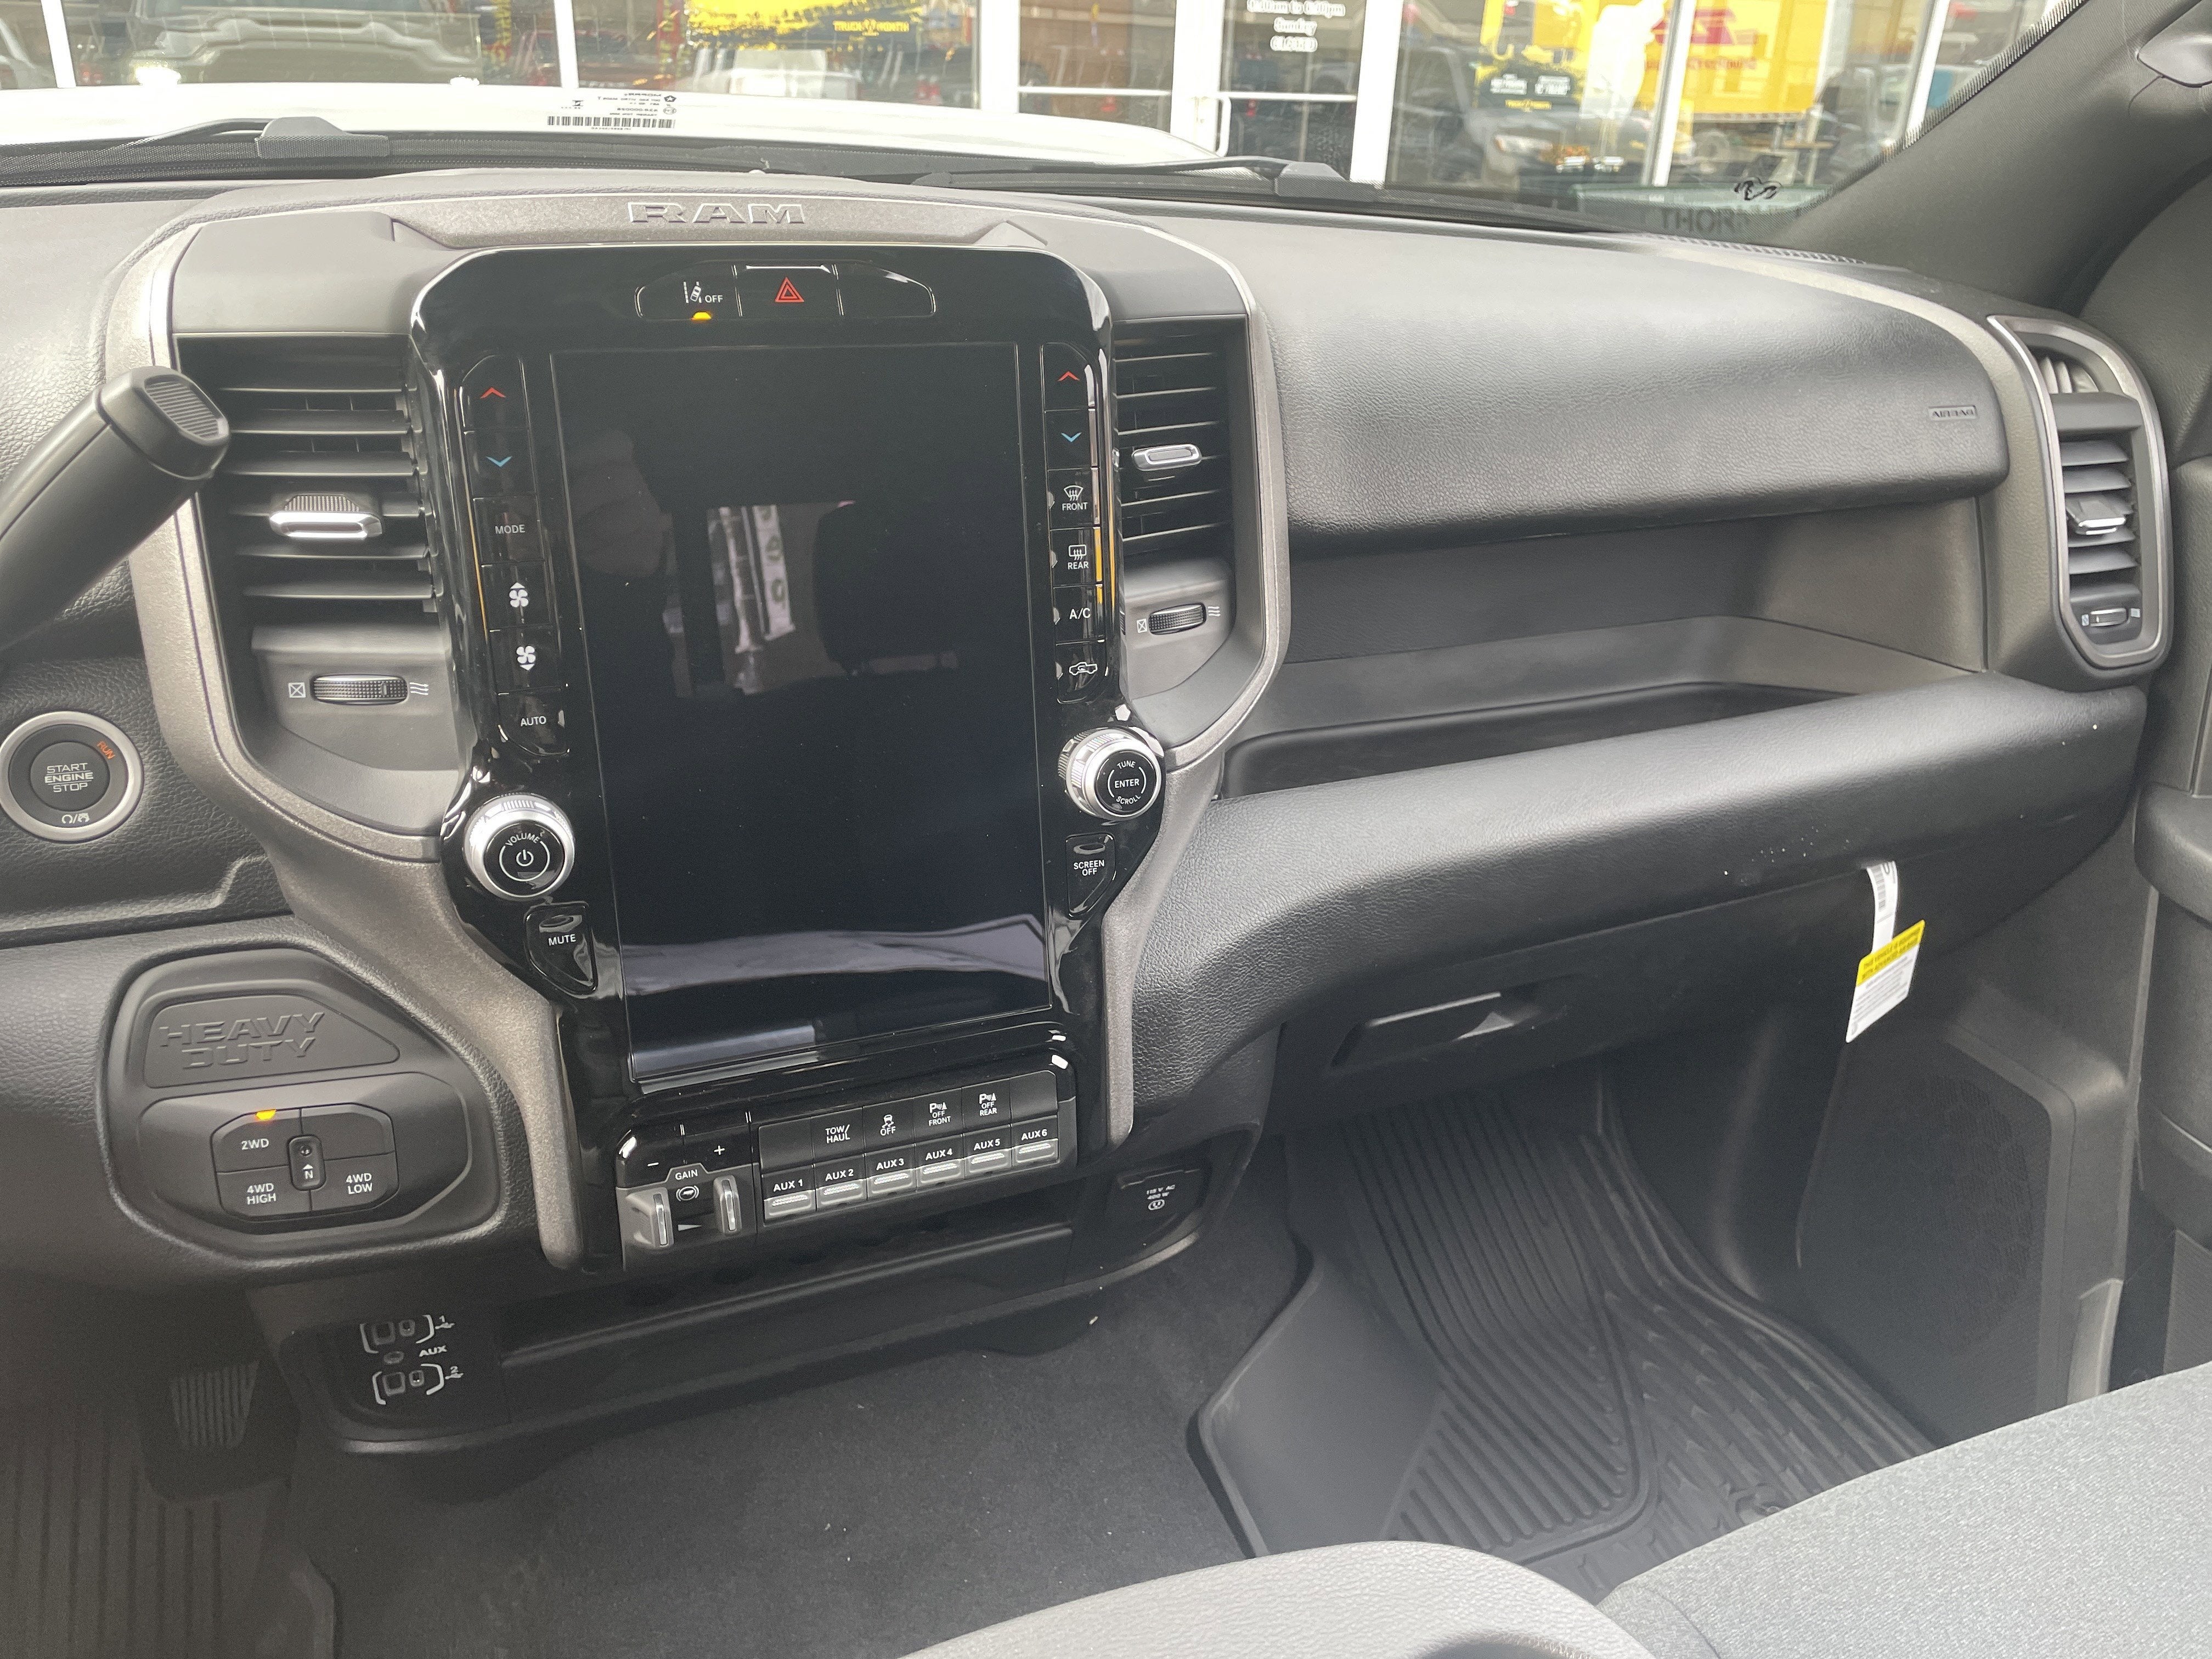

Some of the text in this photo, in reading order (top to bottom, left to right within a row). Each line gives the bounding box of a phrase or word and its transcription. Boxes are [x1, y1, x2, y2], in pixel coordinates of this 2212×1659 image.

[627, 201, 806, 224] RAM
[705, 295, 723, 303] OFF
[1062, 501, 1088, 511] FRONT
[495, 524, 526, 534] MODE
[1068, 561, 1089, 570] REAR
[1069, 607, 1091, 620] A/C
[521, 715, 547, 727] AUTO
[97, 741, 115, 759] RUN
[47, 762, 88, 774] START
[1117, 760, 1136, 769] TUNE
[44, 771, 94, 783] ENGINE
[53, 782, 88, 793] STOP
[1114, 778, 1140, 789] ENTER
[1116, 794, 1141, 805] SCROLL
[505, 832, 540, 847] VOLUME
[1073, 859, 1105, 870] SCREEN
[1082, 867, 1098, 876] OFF
[548, 934, 577, 946] MUTE
[159, 1012, 325, 1047] HEAVY
[182, 1037, 316, 1069] DUTY
[932, 1110, 946, 1118] OFF
[979, 1107, 997, 1116] REAR
[928, 1115, 951, 1126] FRONT
[825, 1124, 850, 1136] TOW/
[880, 1126, 896, 1136] OFF
[1021, 1128, 1048, 1141] AUX 6
[241, 1138, 269, 1150] 2WD
[826, 1132, 851, 1144] HAUL
[973, 1138, 1001, 1150] AUX 5
[925, 1148, 953, 1160] AUX 4
[876, 1158, 905, 1171] AUX 3
[304, 1169, 313, 1180] N
[346, 1172, 373, 1184] 4WD
[674, 1169, 698, 1181] GAIN
[825, 1168, 854, 1181] AUX 2
[246, 1182, 275, 1194] 4WD
[347, 1182, 373, 1194] LOW
[773, 1178, 803, 1192] AUX 1
[246, 1191, 276, 1205] HIGH
[419, 1345, 448, 1357] AUX
